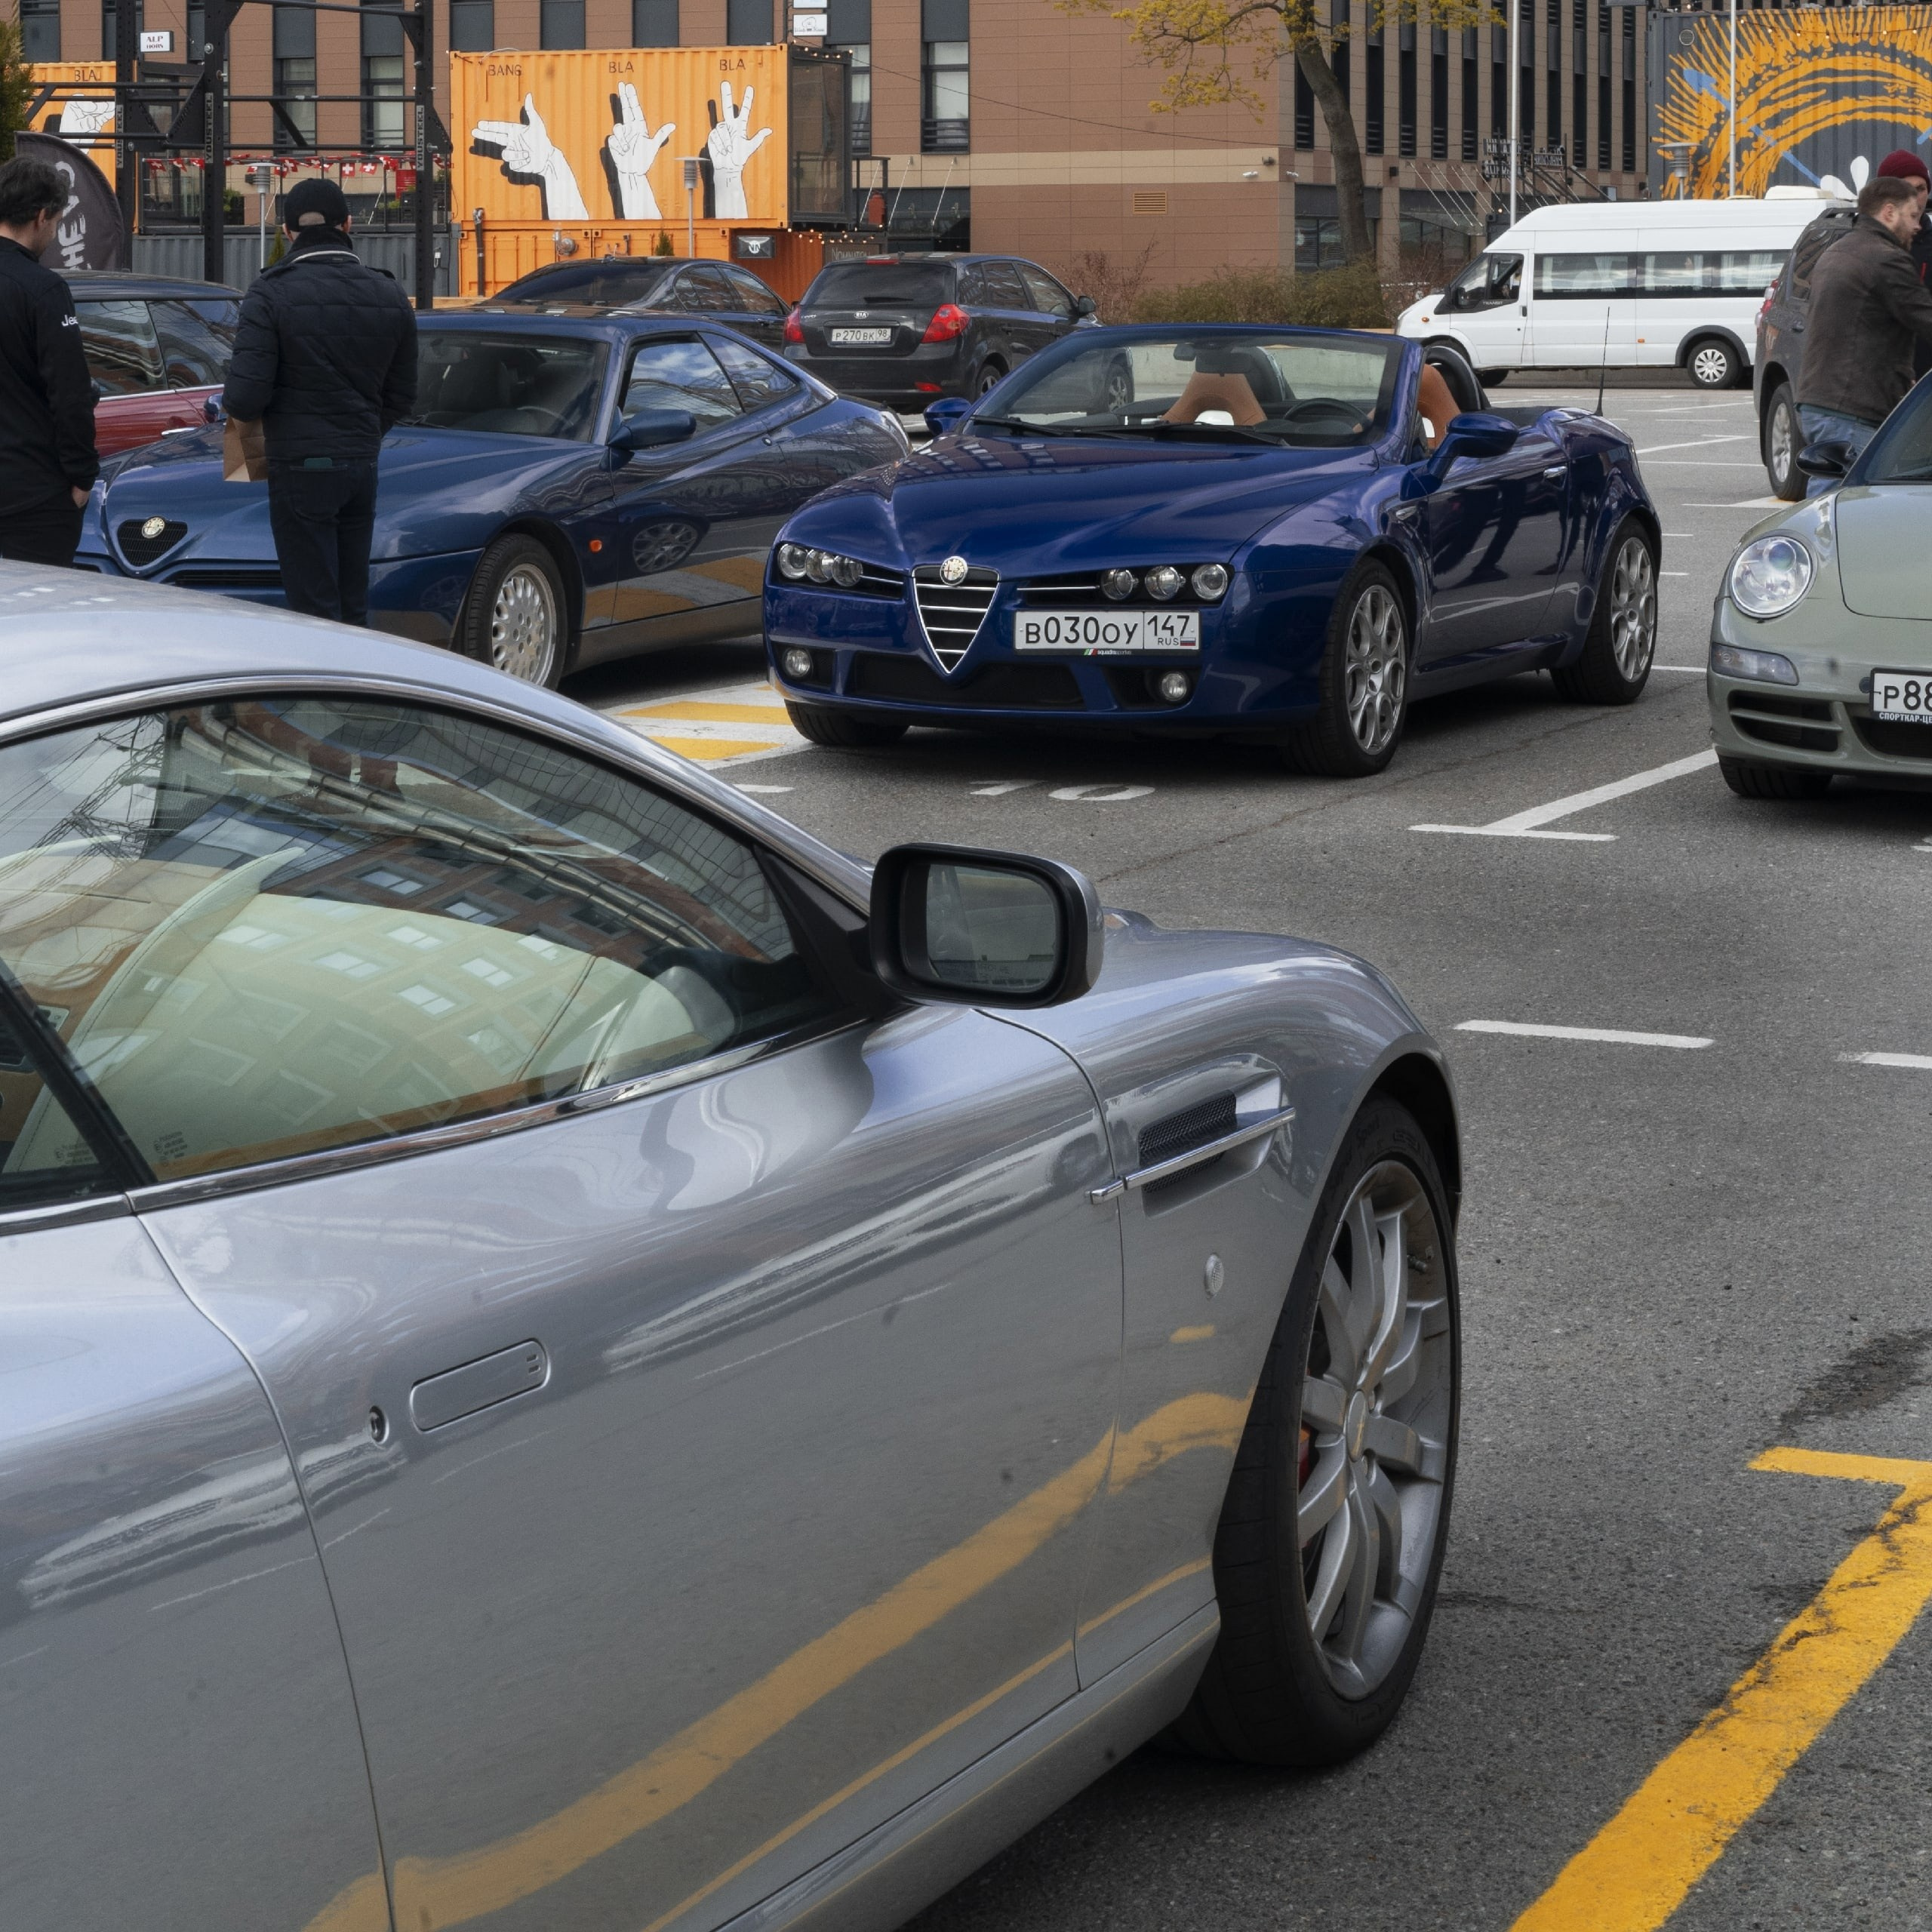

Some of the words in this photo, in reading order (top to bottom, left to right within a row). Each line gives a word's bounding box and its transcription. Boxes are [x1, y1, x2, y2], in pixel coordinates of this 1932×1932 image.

[488, 64, 522, 76] BANG
[608, 61, 635, 73] BLA
[719, 59, 746, 71] BLA
[74, 69, 97, 82] BLA
[1147, 615, 1190, 637] 147
[1157, 636, 1180, 646] RUS
